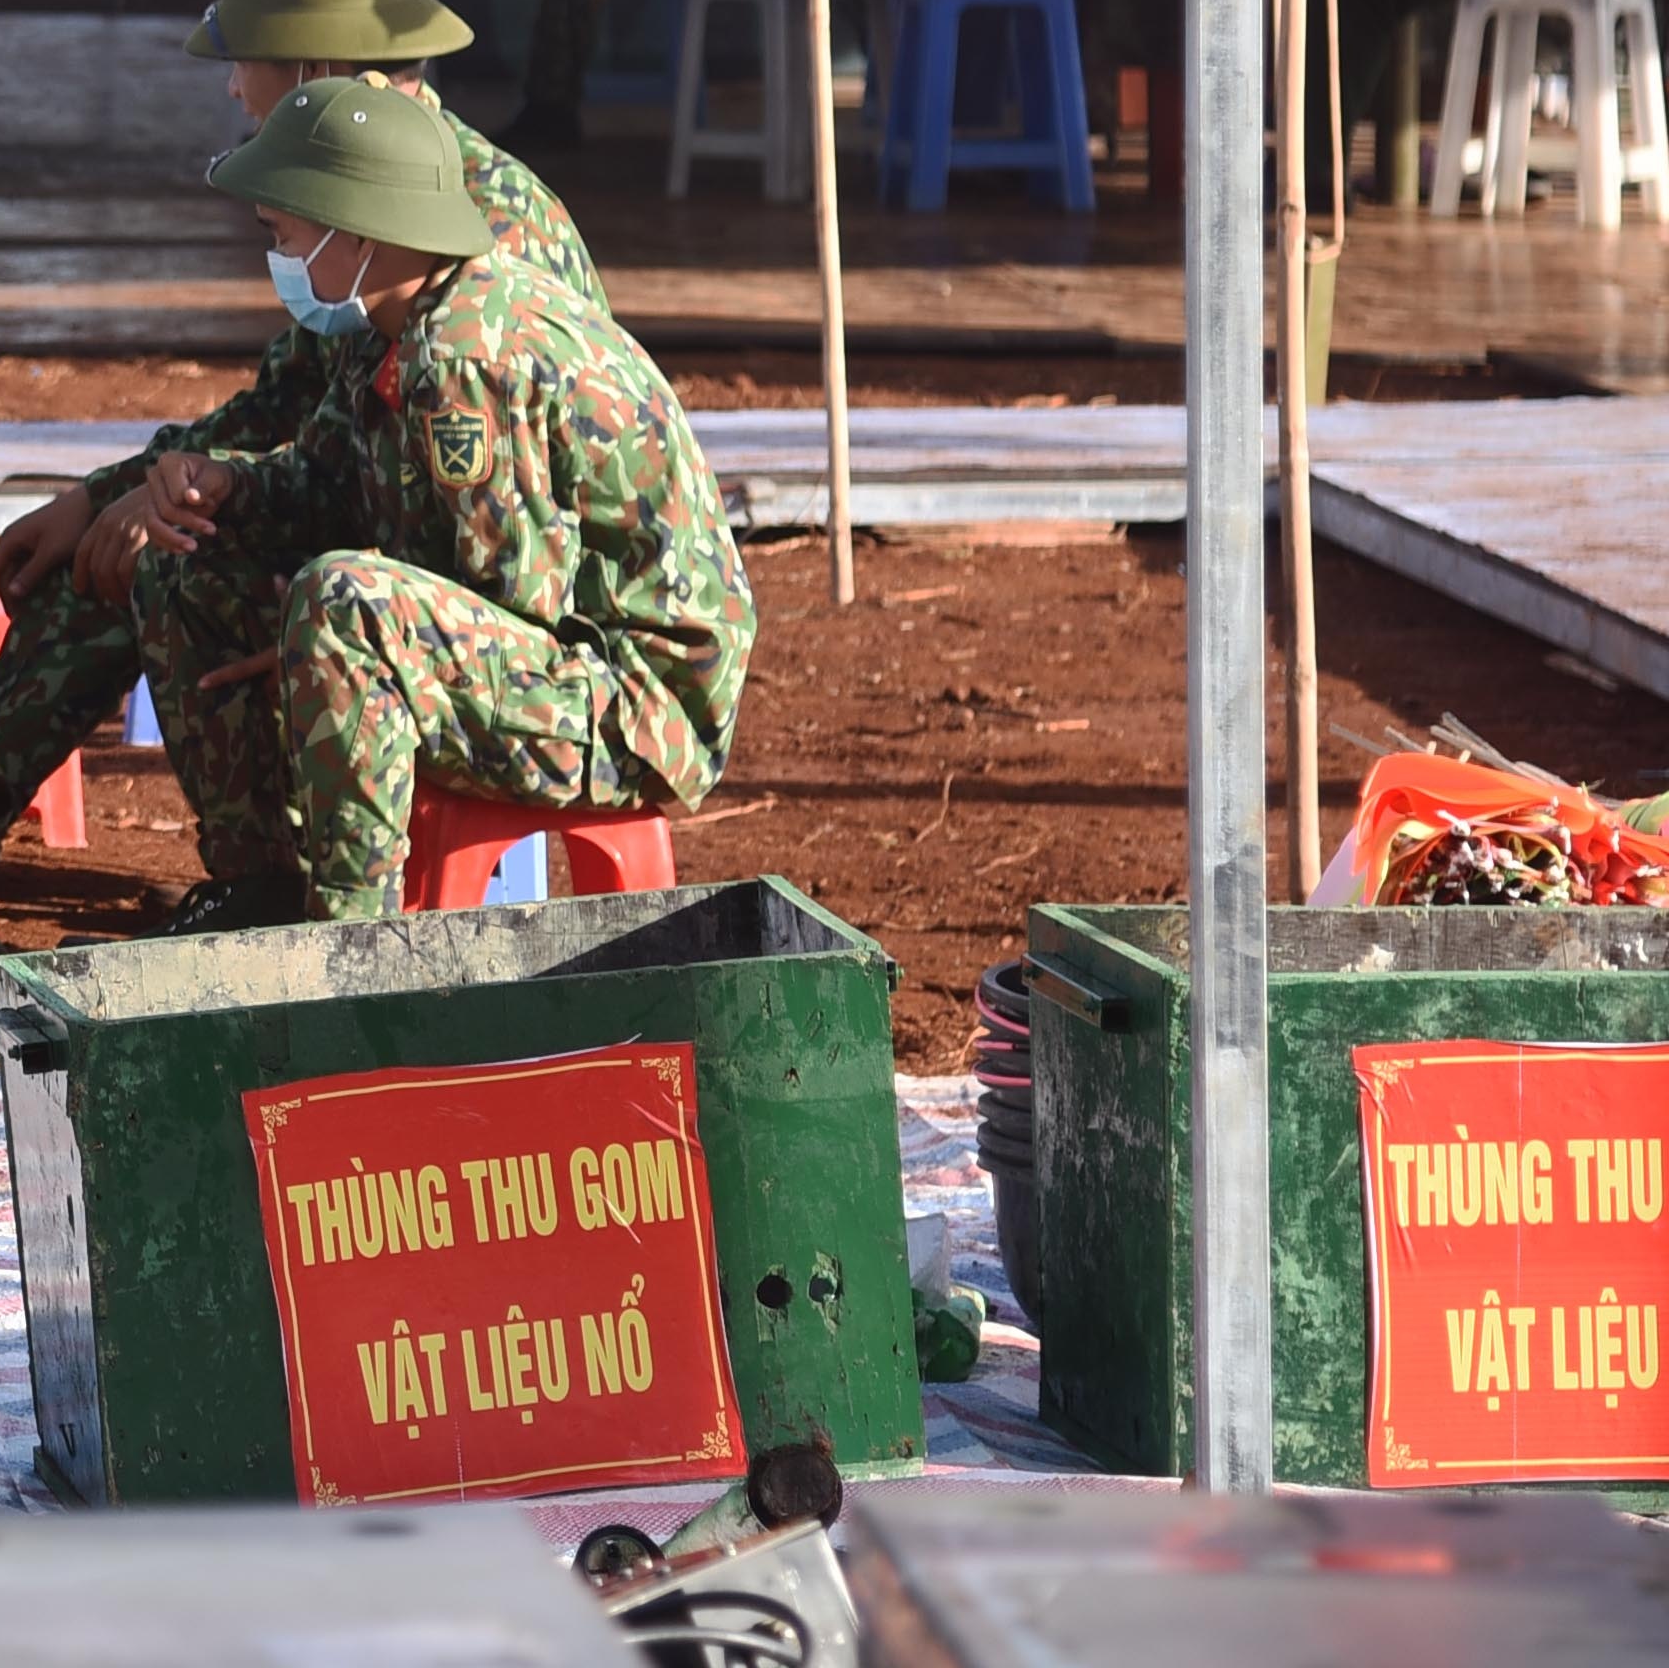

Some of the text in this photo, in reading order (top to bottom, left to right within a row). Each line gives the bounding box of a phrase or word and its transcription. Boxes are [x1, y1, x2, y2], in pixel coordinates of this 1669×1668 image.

[288, 1140, 684, 1266] THÙNG THU GOM
[1388, 1124, 1663, 1227] THÙNG THU
[357, 1273, 655, 1441] VẬT LIỆU NỔ
[1446, 1287, 1658, 1411] VẬT LIỆU
